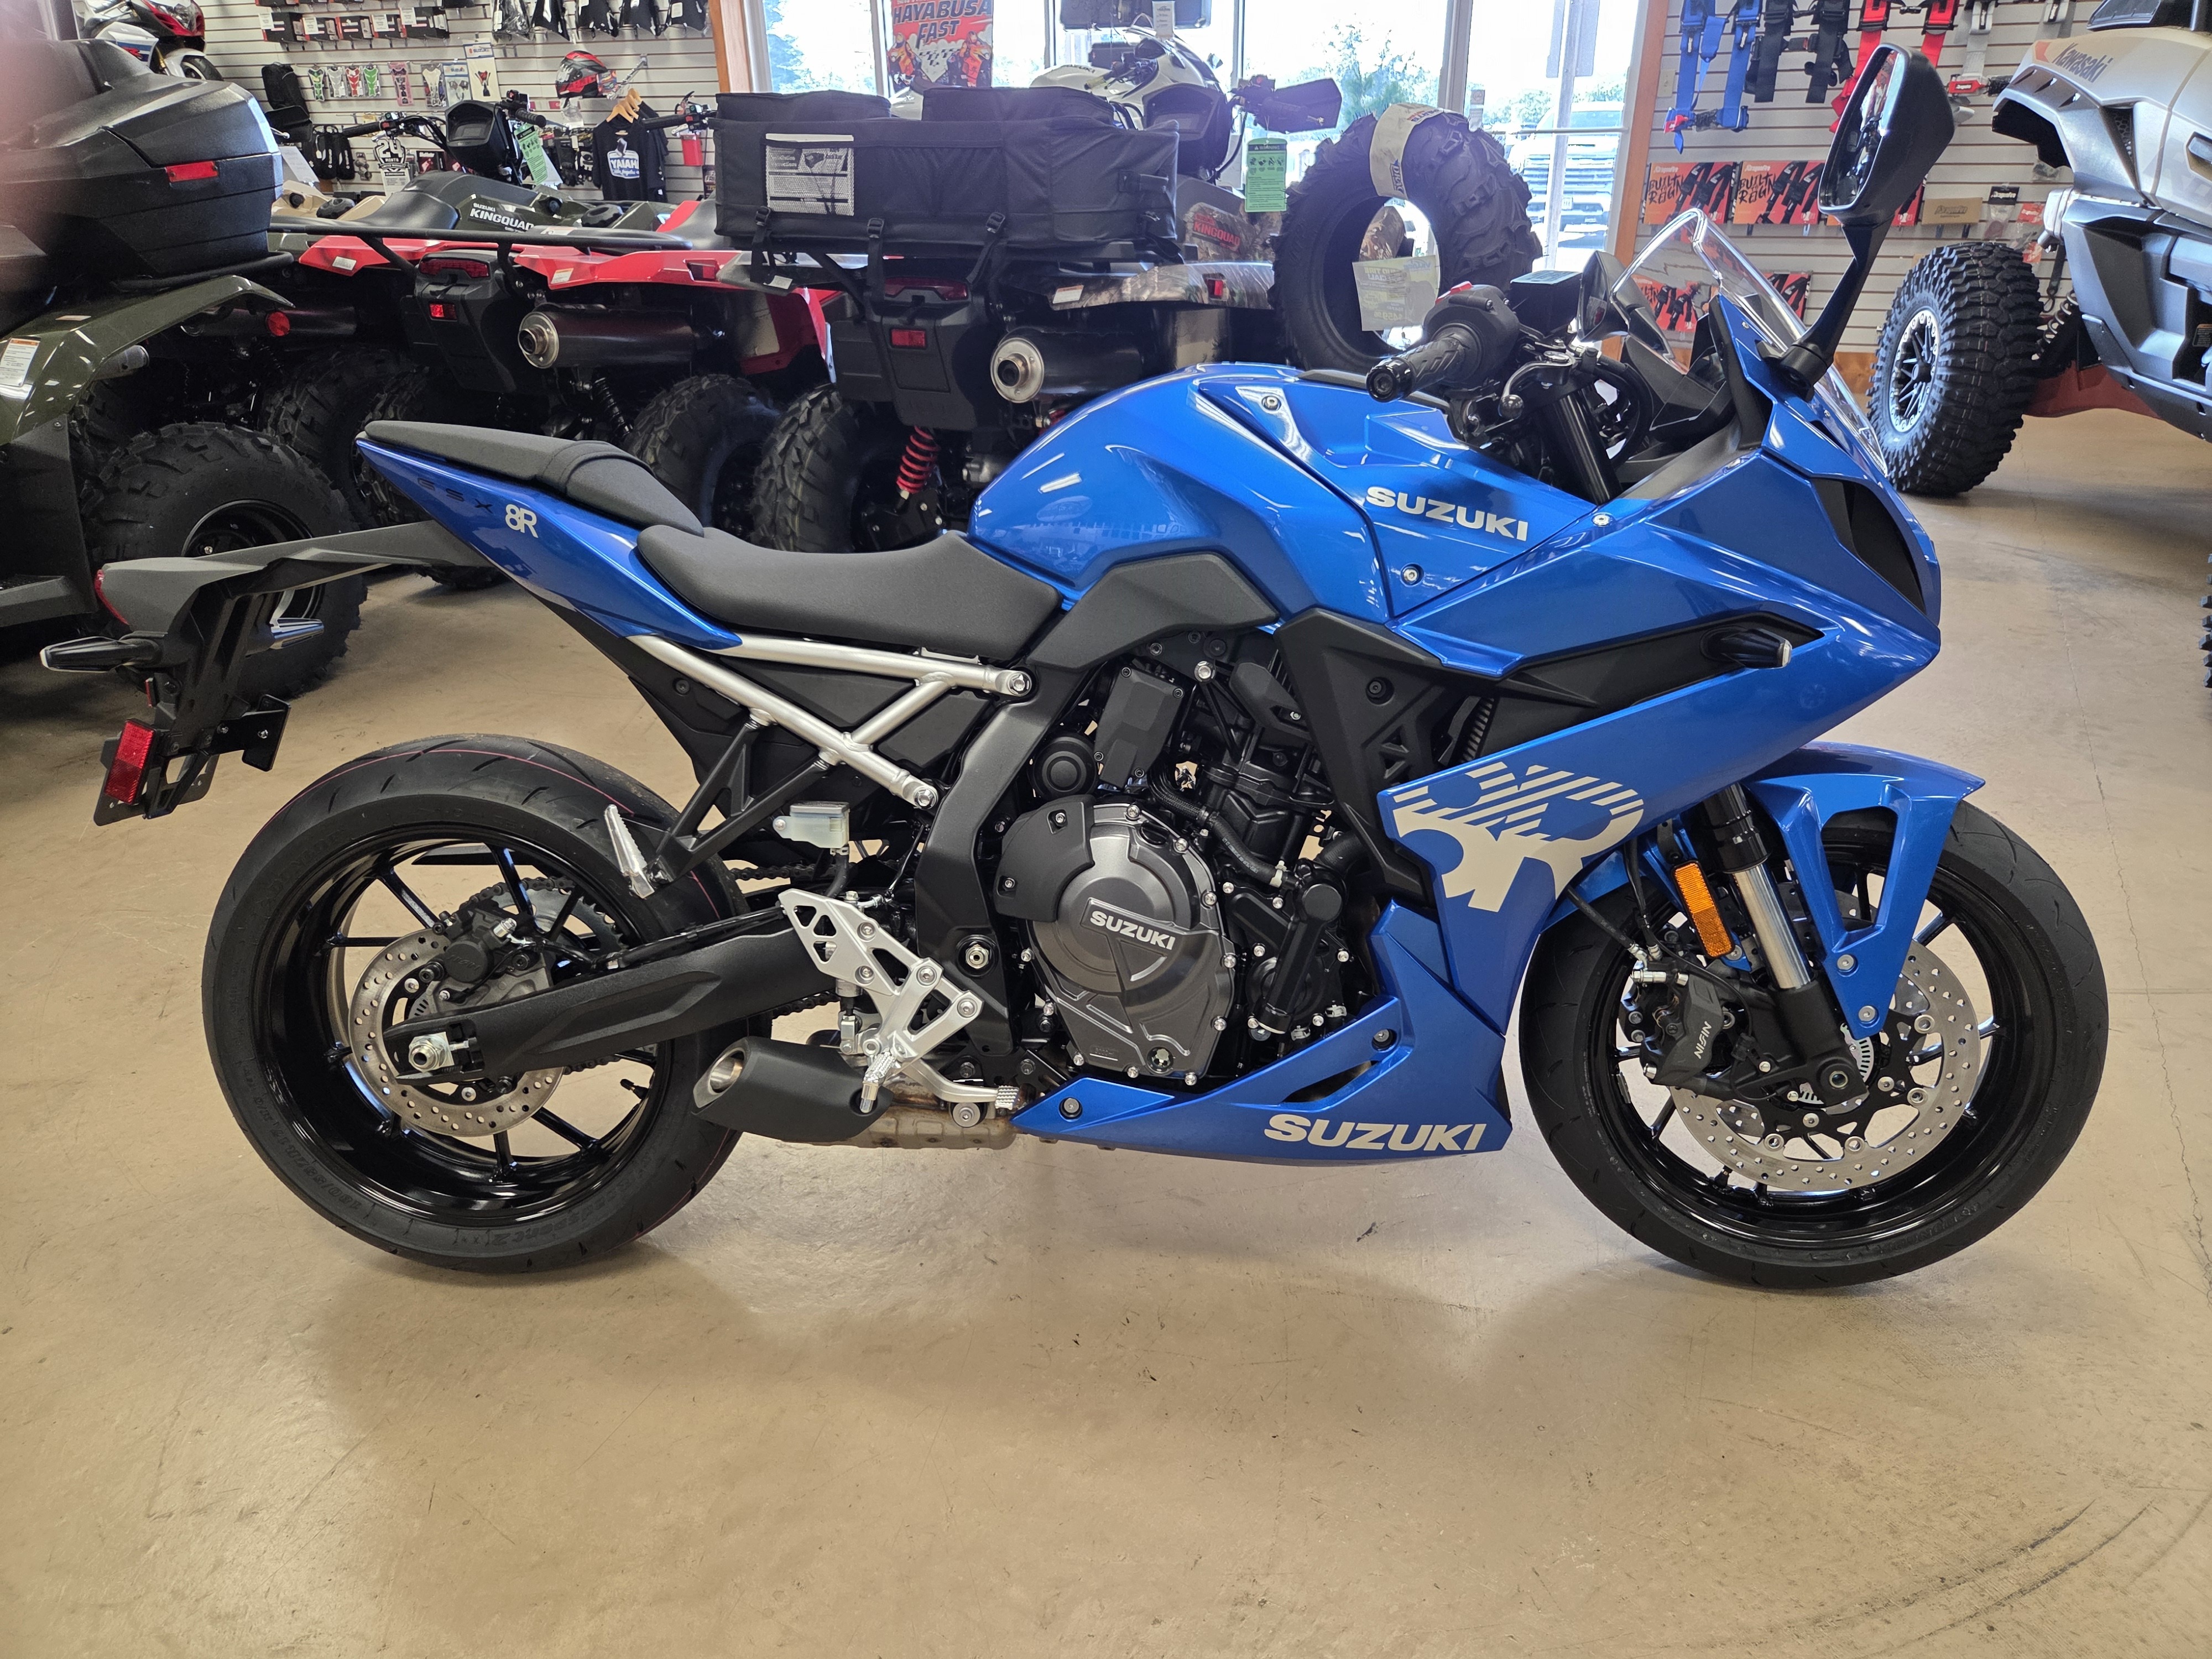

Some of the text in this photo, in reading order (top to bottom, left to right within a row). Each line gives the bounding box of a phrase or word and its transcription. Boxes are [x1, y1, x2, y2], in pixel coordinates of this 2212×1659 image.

[893, 0, 993, 24] HAYABUSA
[915, 20, 960, 49] FAST
[2052, 43, 2113, 83] Kawasaki
[376, 138, 403, 158] 24
[610, 159, 639, 169] YAAH
[1648, 173, 1681, 192] BUILT
[1739, 171, 1773, 191] BUILT
[470, 208, 535, 231] KINGQUAD
[473, 202, 496, 212] SUZUKI
[1193, 221, 1241, 247] KINGQUAD
[505, 504, 539, 539] 8R
[1365, 486, 1529, 542] SUZUKI
[1089, 910, 1176, 951] SUZUKI
[1694, 1020, 1712, 1060] NISSIN
[1264, 1114, 1488, 1151] SUZUKI
